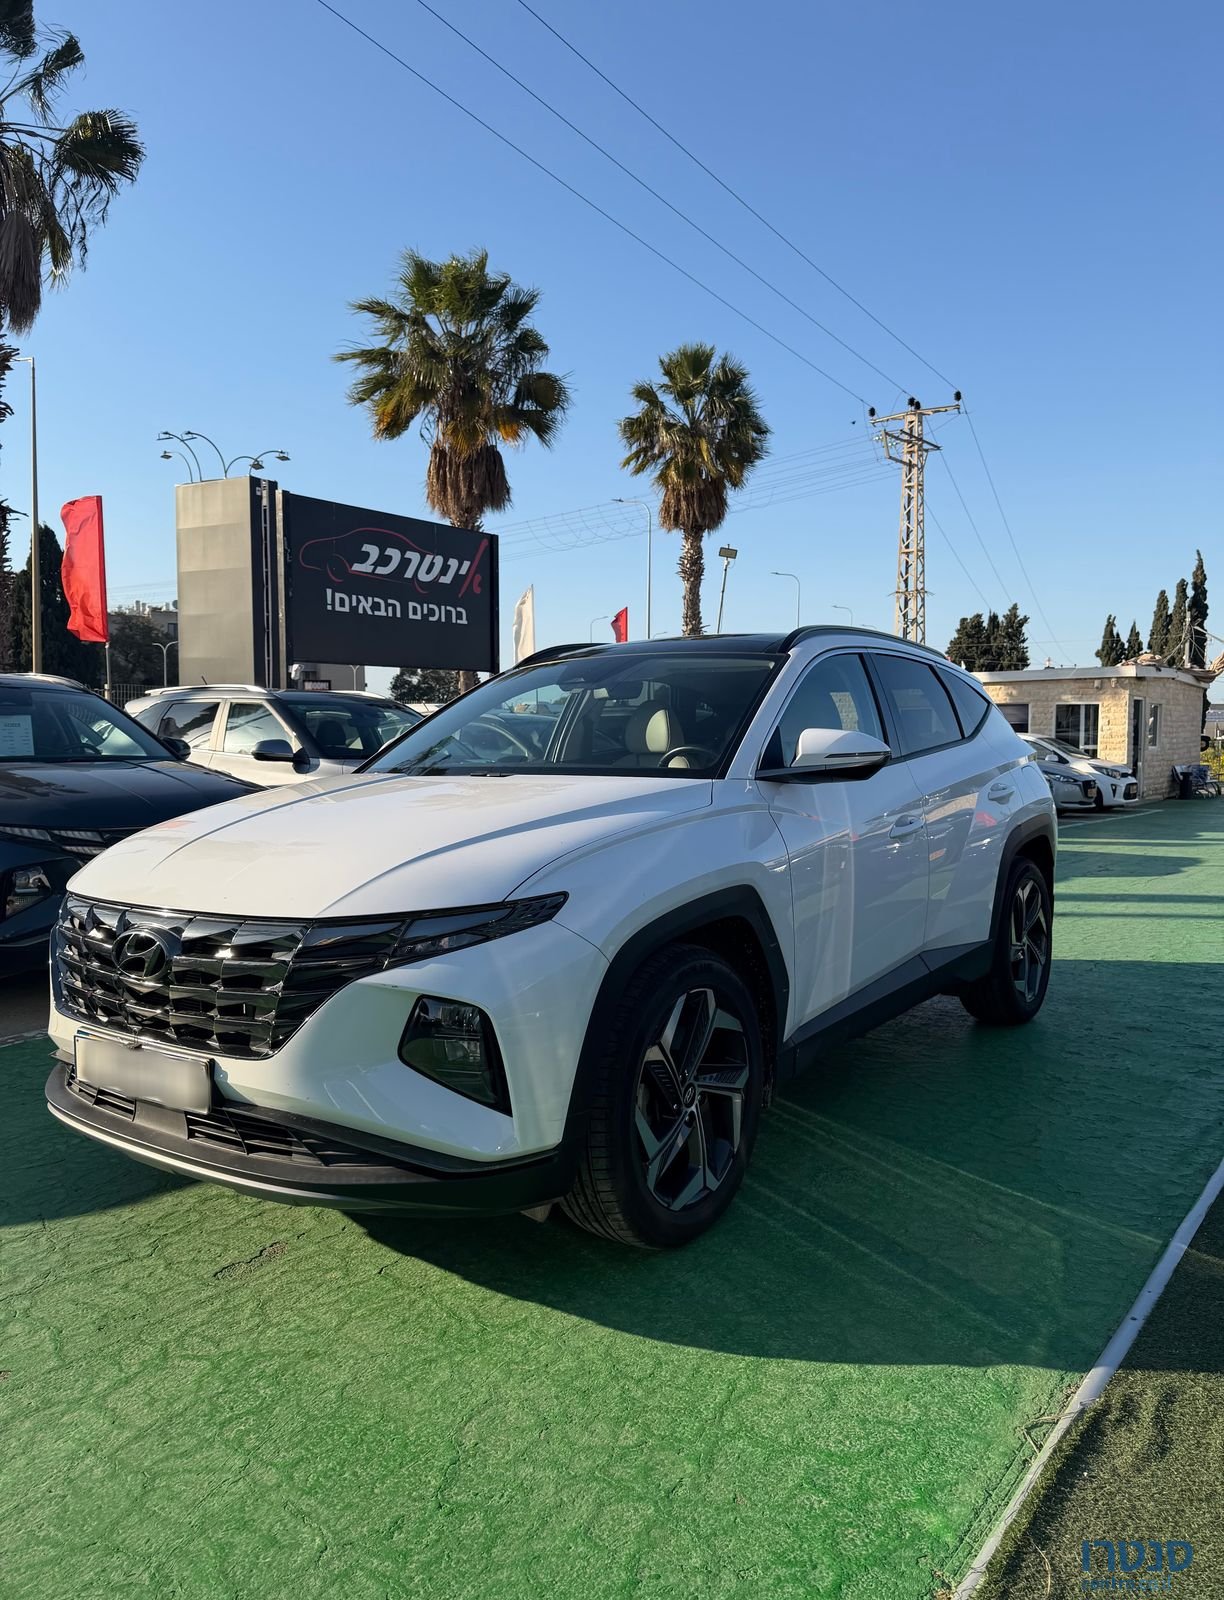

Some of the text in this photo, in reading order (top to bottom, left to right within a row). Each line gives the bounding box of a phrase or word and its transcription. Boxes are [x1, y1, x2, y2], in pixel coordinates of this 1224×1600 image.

[351, 538, 489, 599] אינטרכב
[326, 588, 468, 625] ברוכים הבאים!
